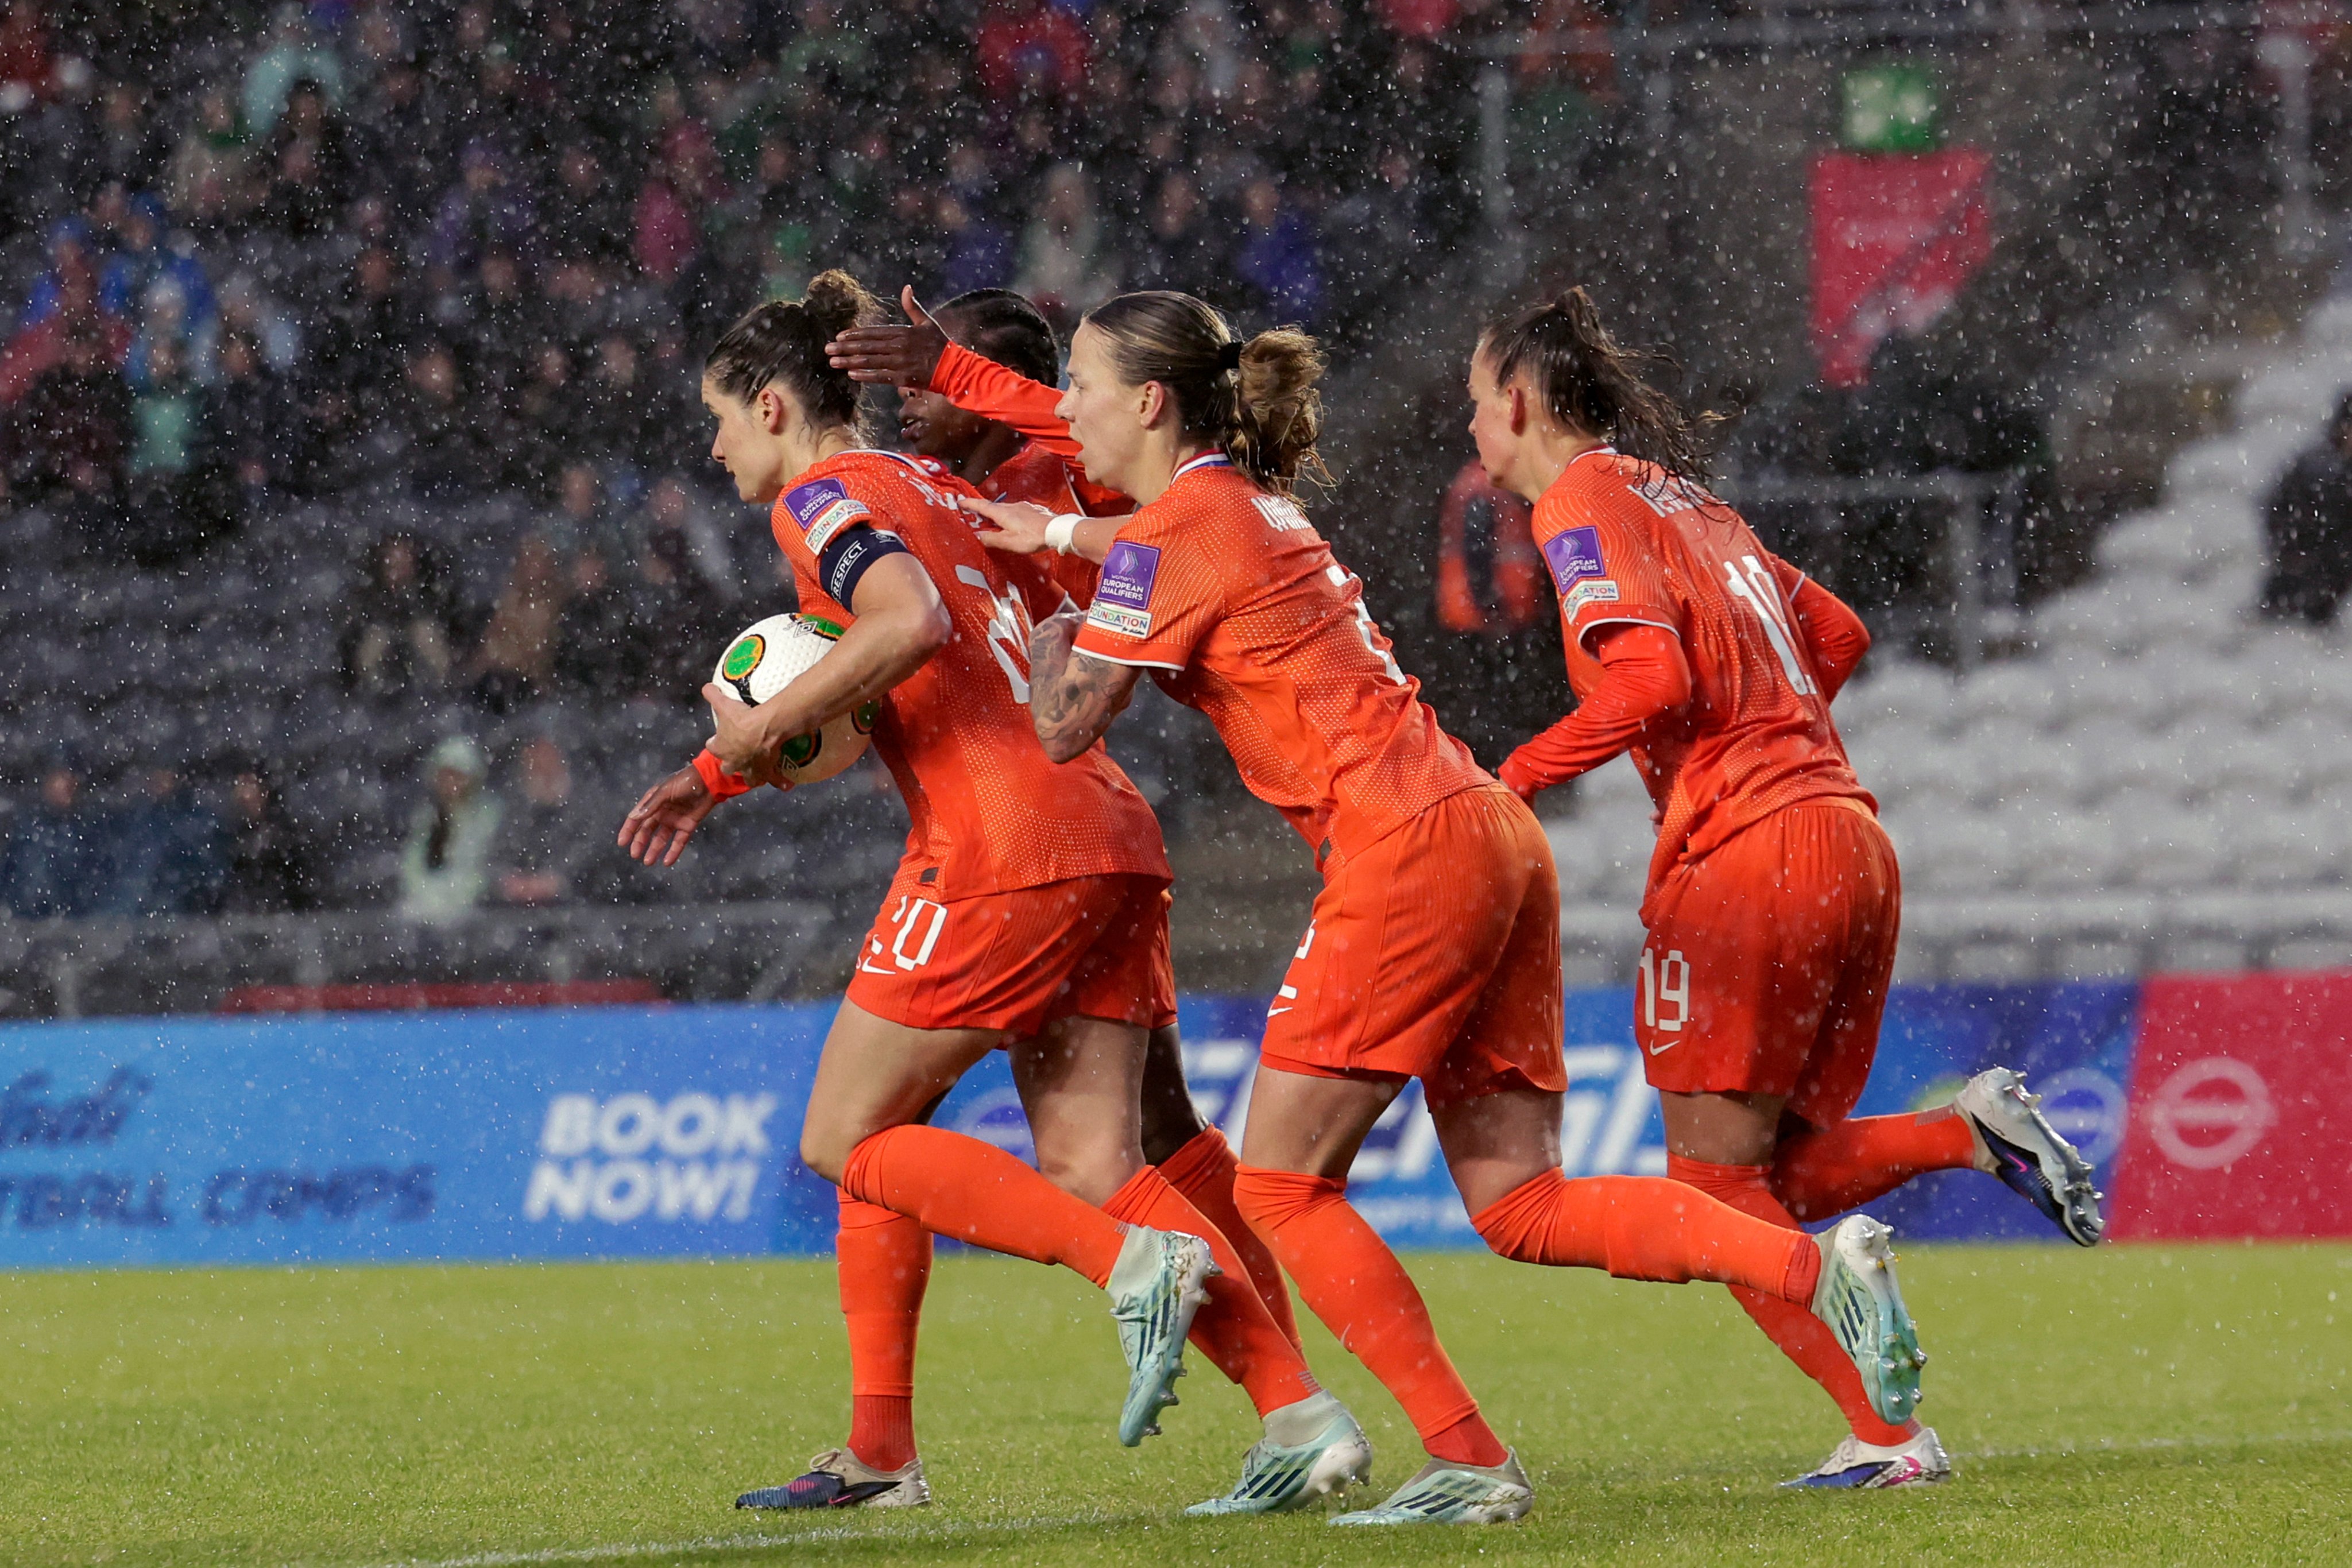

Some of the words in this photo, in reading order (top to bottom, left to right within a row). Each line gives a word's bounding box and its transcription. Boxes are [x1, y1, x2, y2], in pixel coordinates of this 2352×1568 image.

[833, 542, 863, 597] RESPECT
[1101, 586, 1144, 601] QUALIFIERS
[1103, 579, 1144, 593] EUROPEAN
[1090, 607, 1147, 629] FOUNDATION
[1639, 947, 1690, 1032] 19
[542, 1093, 776, 1156] BOOK
[203, 1164, 436, 1228] CAMPS
[523, 1156, 758, 1223] NOW!
